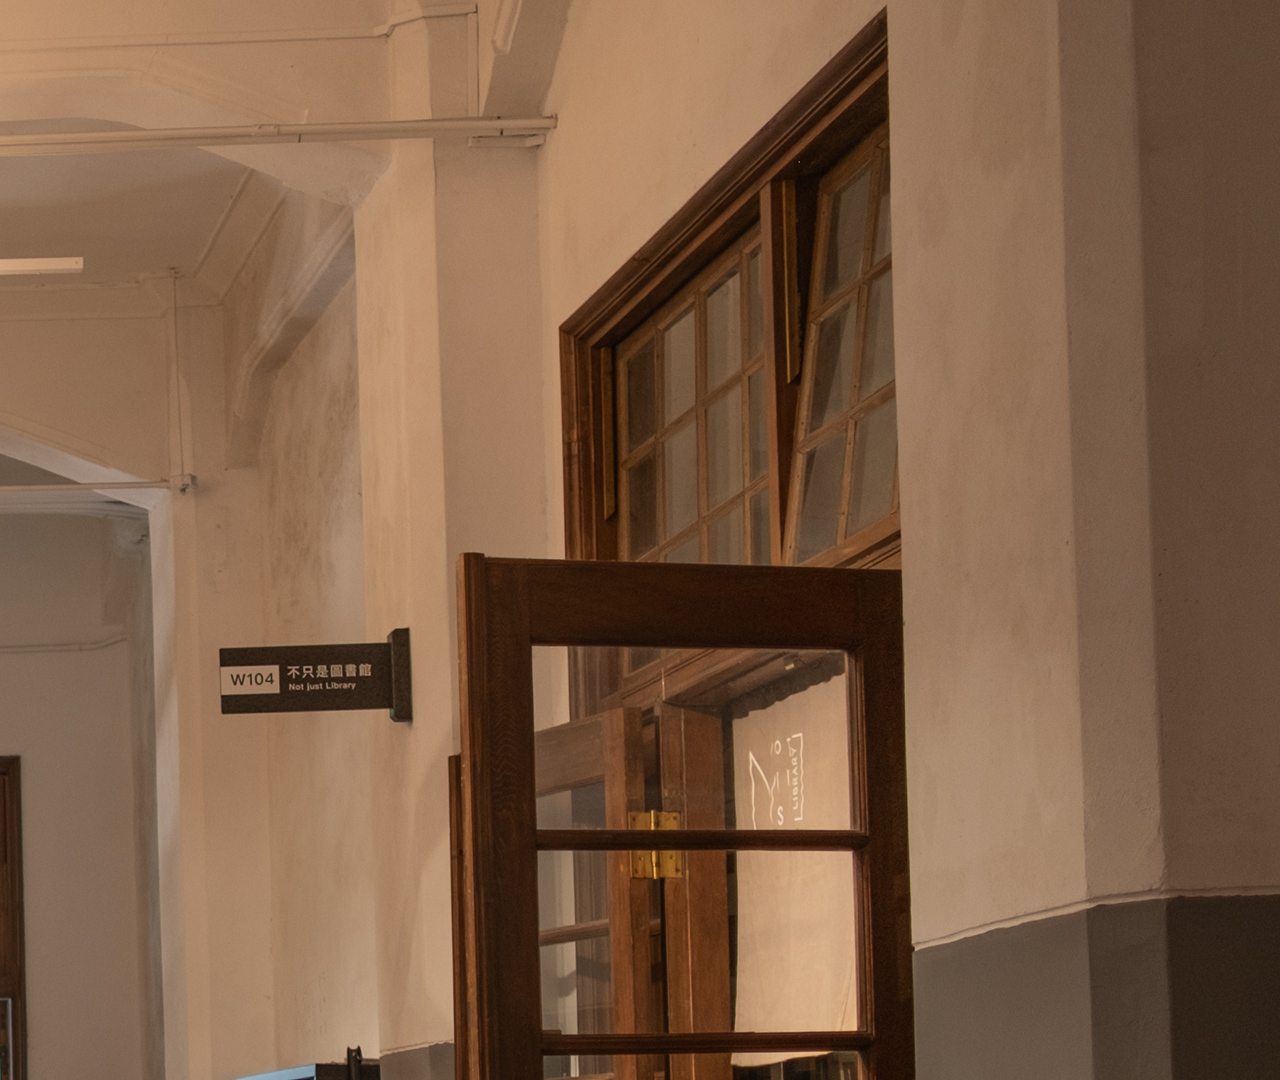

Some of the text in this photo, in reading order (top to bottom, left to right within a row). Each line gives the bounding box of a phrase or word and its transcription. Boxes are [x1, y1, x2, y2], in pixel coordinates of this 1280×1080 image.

[286, 663, 373, 680] 不只是圖書館
[230, 672, 275, 687] W104
[288, 682, 305, 692] Not
[325, 681, 357, 692] Library
